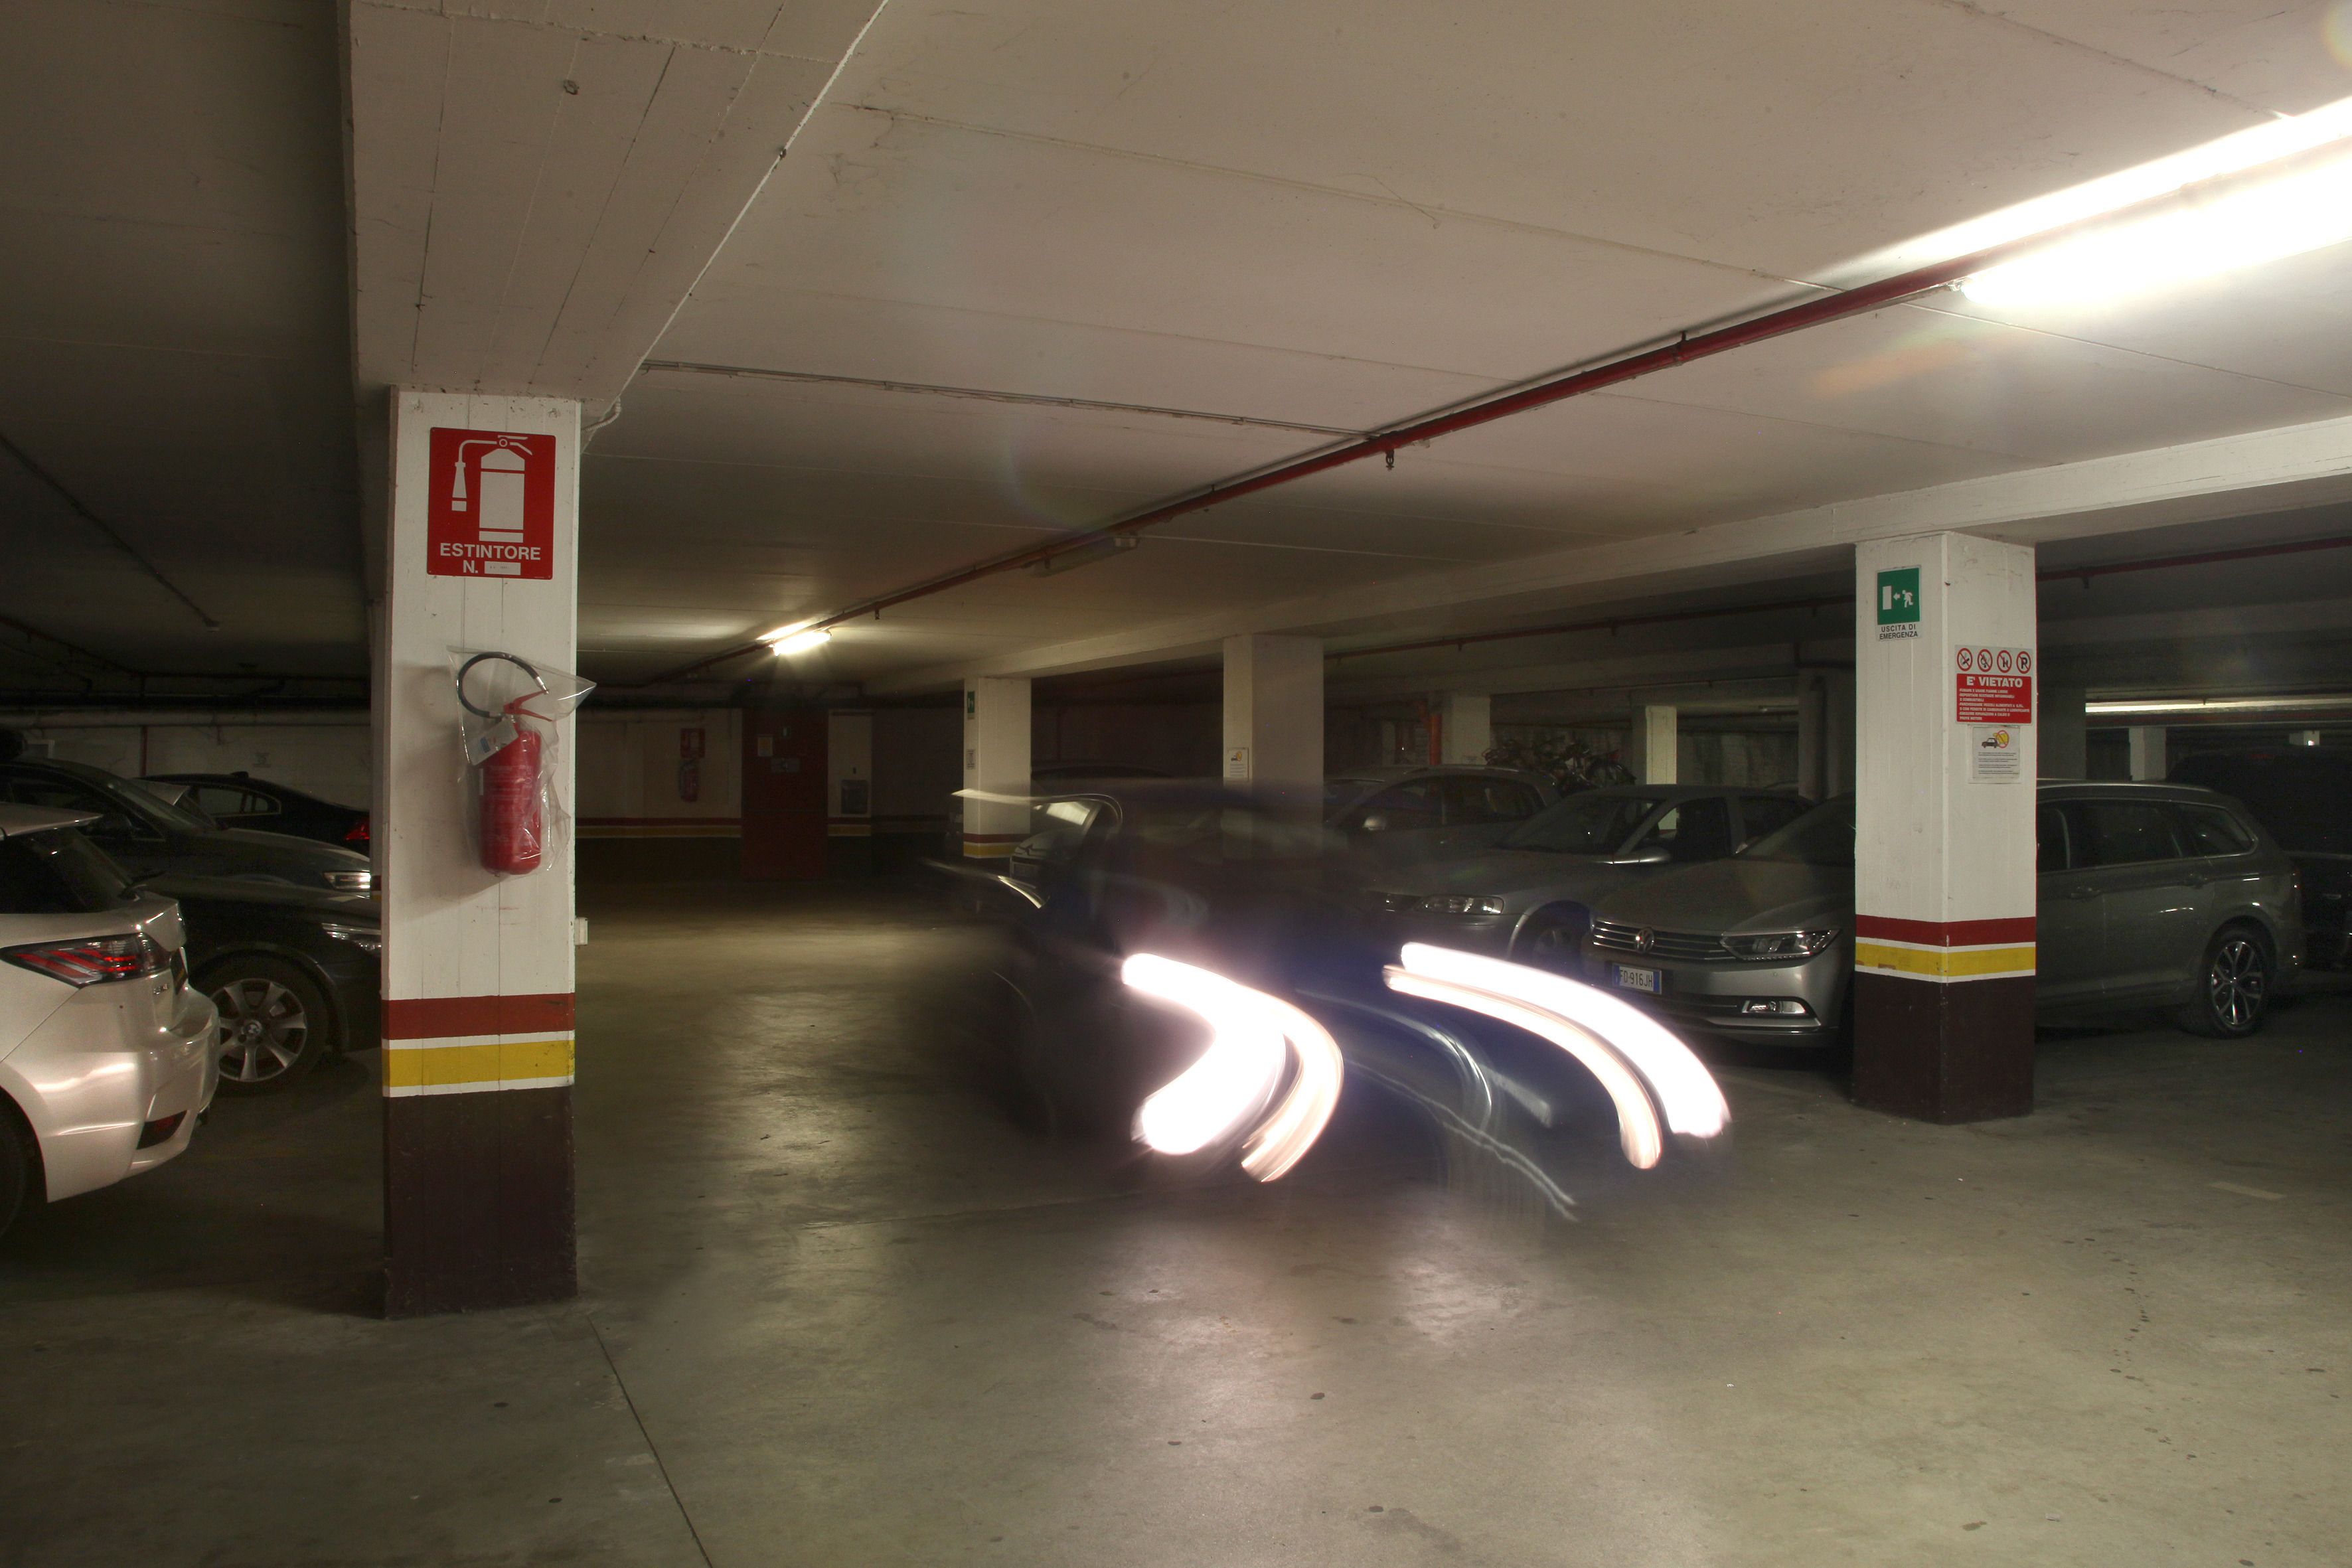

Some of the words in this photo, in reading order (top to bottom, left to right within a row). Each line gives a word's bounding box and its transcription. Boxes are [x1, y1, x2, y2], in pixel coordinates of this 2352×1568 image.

[440, 542, 541, 560] ESTINTORE
[463, 560, 479, 574] N.
[1879, 631, 1918, 640] EMERGENZA
[1966, 676, 1976, 686] E'
[1978, 676, 2023, 688] VIETATO
